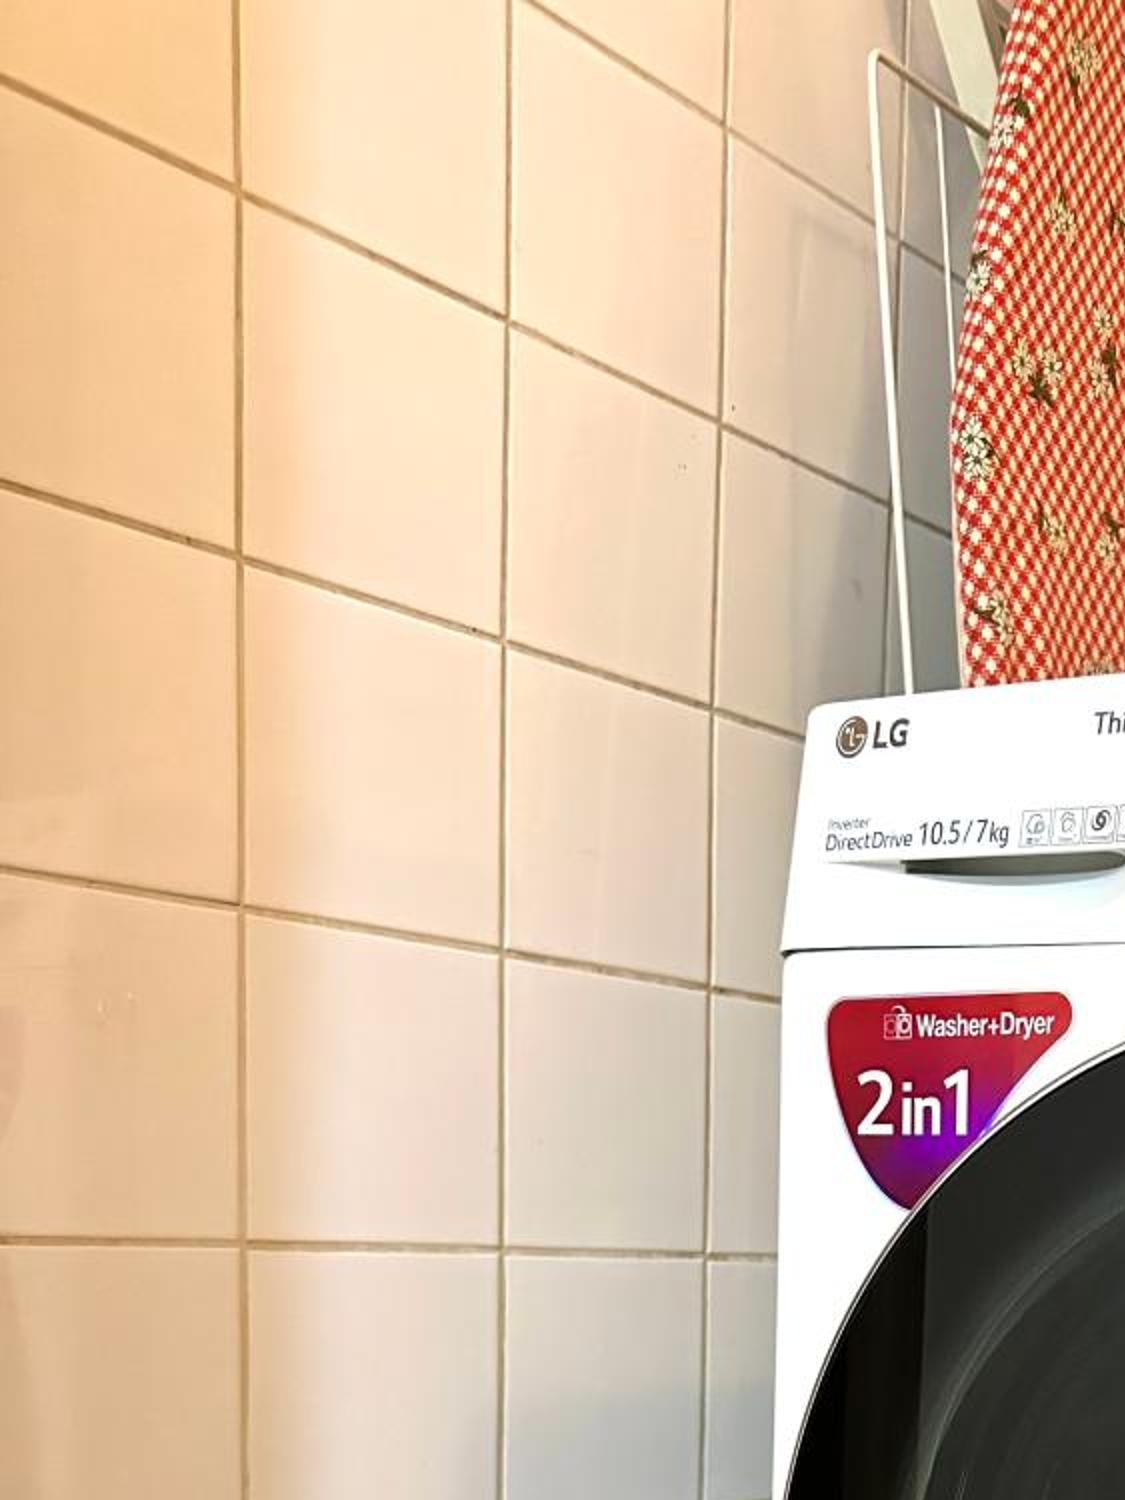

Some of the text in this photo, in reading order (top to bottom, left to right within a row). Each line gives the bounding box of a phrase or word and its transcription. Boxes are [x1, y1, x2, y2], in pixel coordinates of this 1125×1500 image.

[872, 717, 911, 749] LG
[827, 817, 872, 831] Inverter
[916, 1011, 1056, 1041] Washer+Dryer
